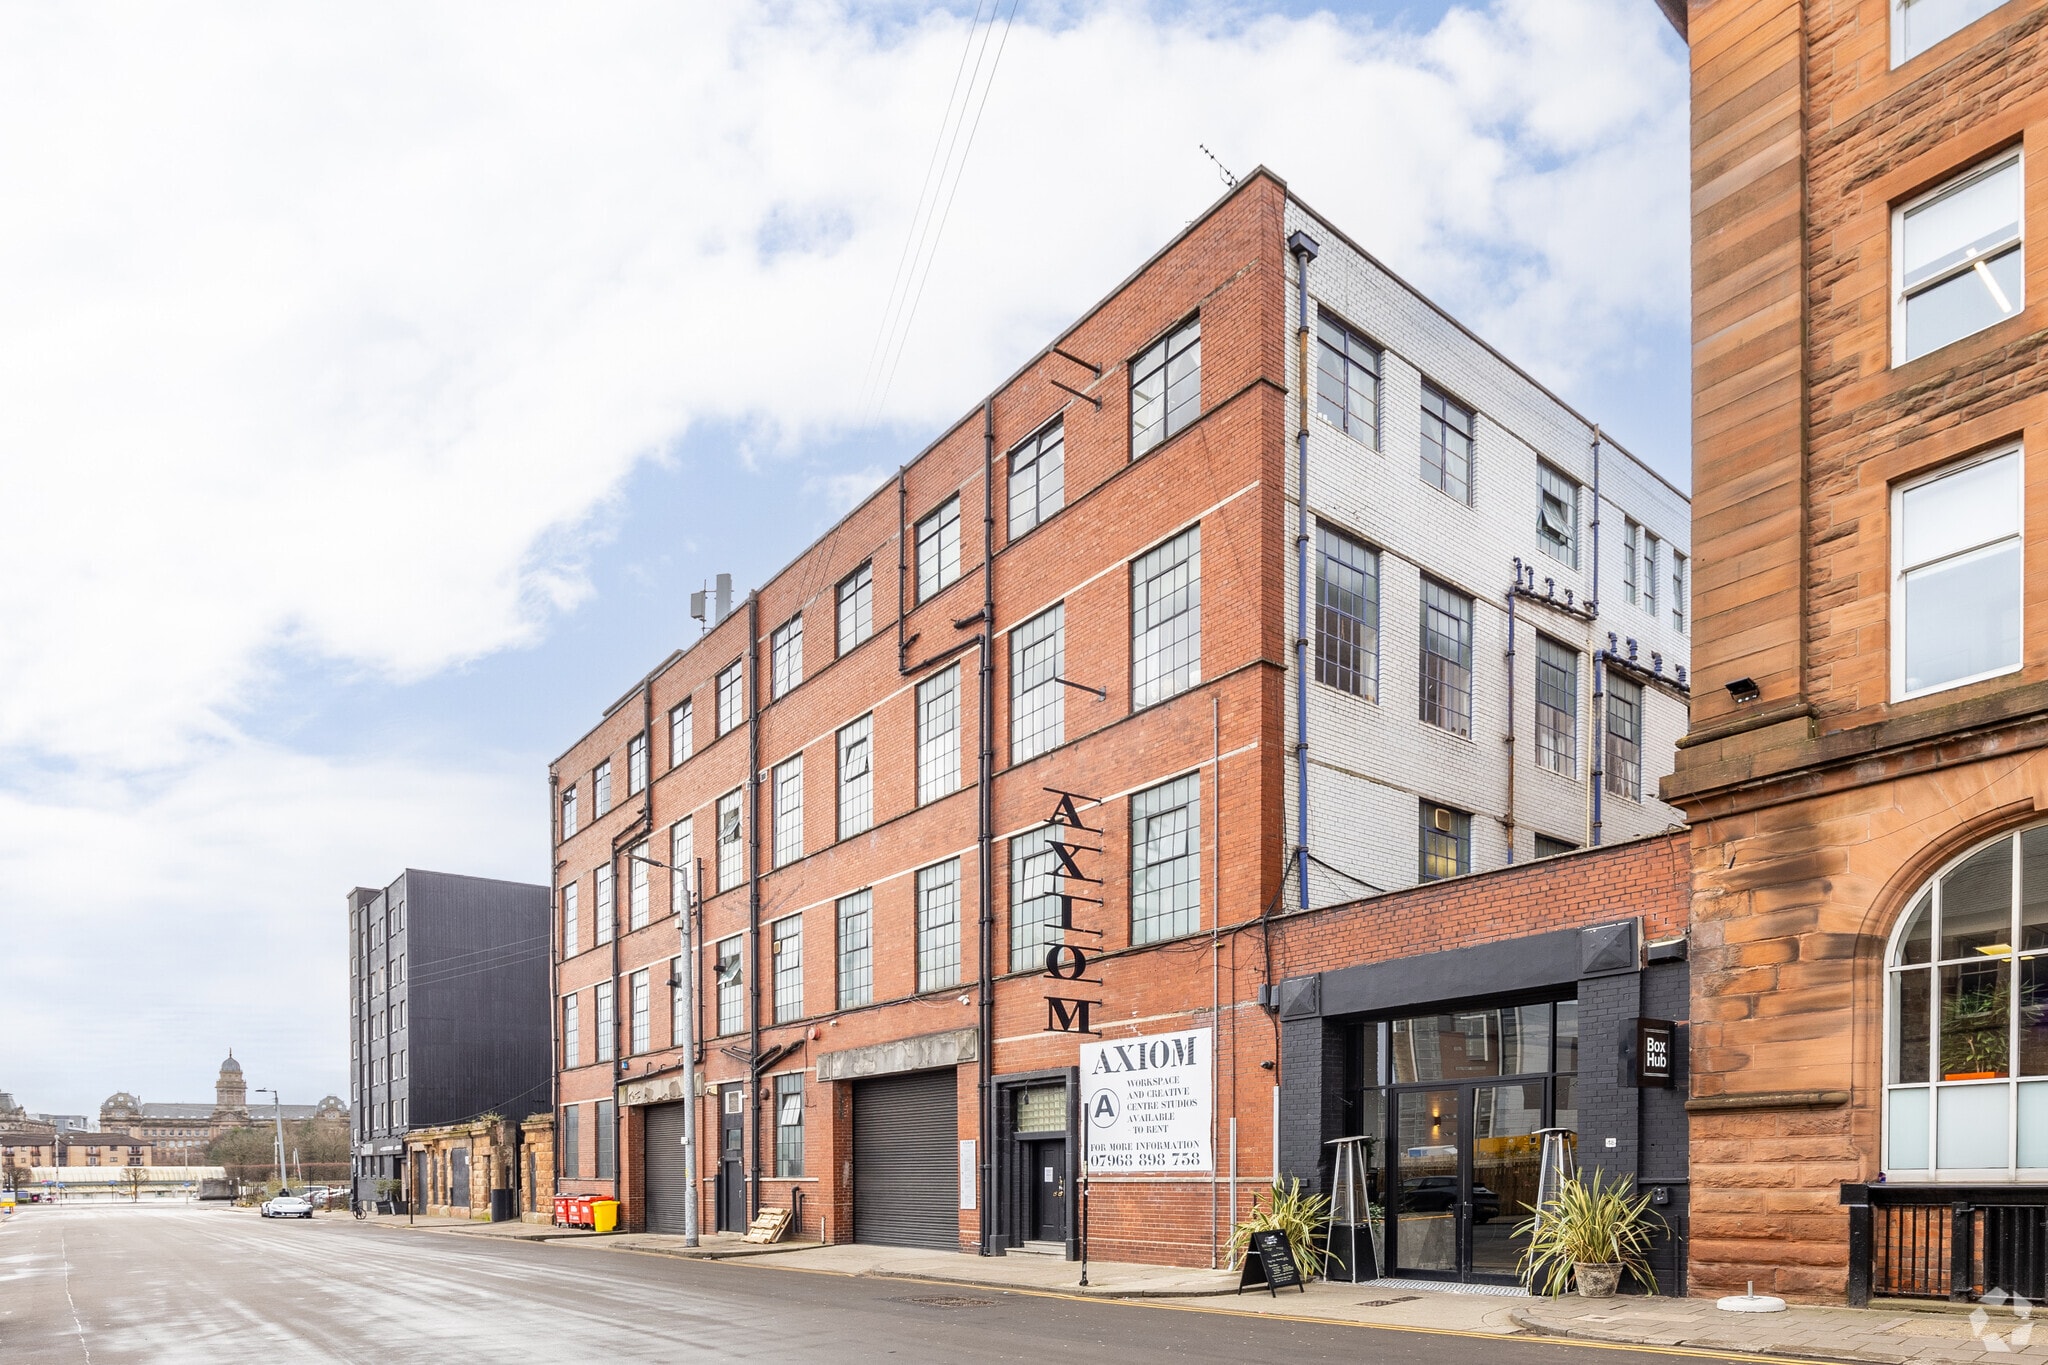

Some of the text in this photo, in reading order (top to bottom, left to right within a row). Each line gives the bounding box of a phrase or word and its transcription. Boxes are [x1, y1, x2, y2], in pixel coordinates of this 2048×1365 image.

[1045, 791, 1090, 1035] AXIOM
[1647, 1037, 1666, 1053] Box
[1092, 1036, 1197, 1075] AXIOM
[1646, 1052, 1667, 1068] Hub
[1127, 1076, 1180, 1087] WORKSPACE
[1127, 1087, 1190, 1100] AND CREATIVE
[1094, 1094, 1115, 1118] A
[1127, 1099, 1198, 1111] CENTRE STUDIOS
[1127, 1112, 1175, 1123] AVAILABLE
[1133, 1125, 1169, 1134] TO RENT
[1090, 1140, 1200, 1151] FOR MORE INFORMATION
[1090, 1154, 1133, 1167] 07968
[1138, 1153, 1166, 1166] 898
